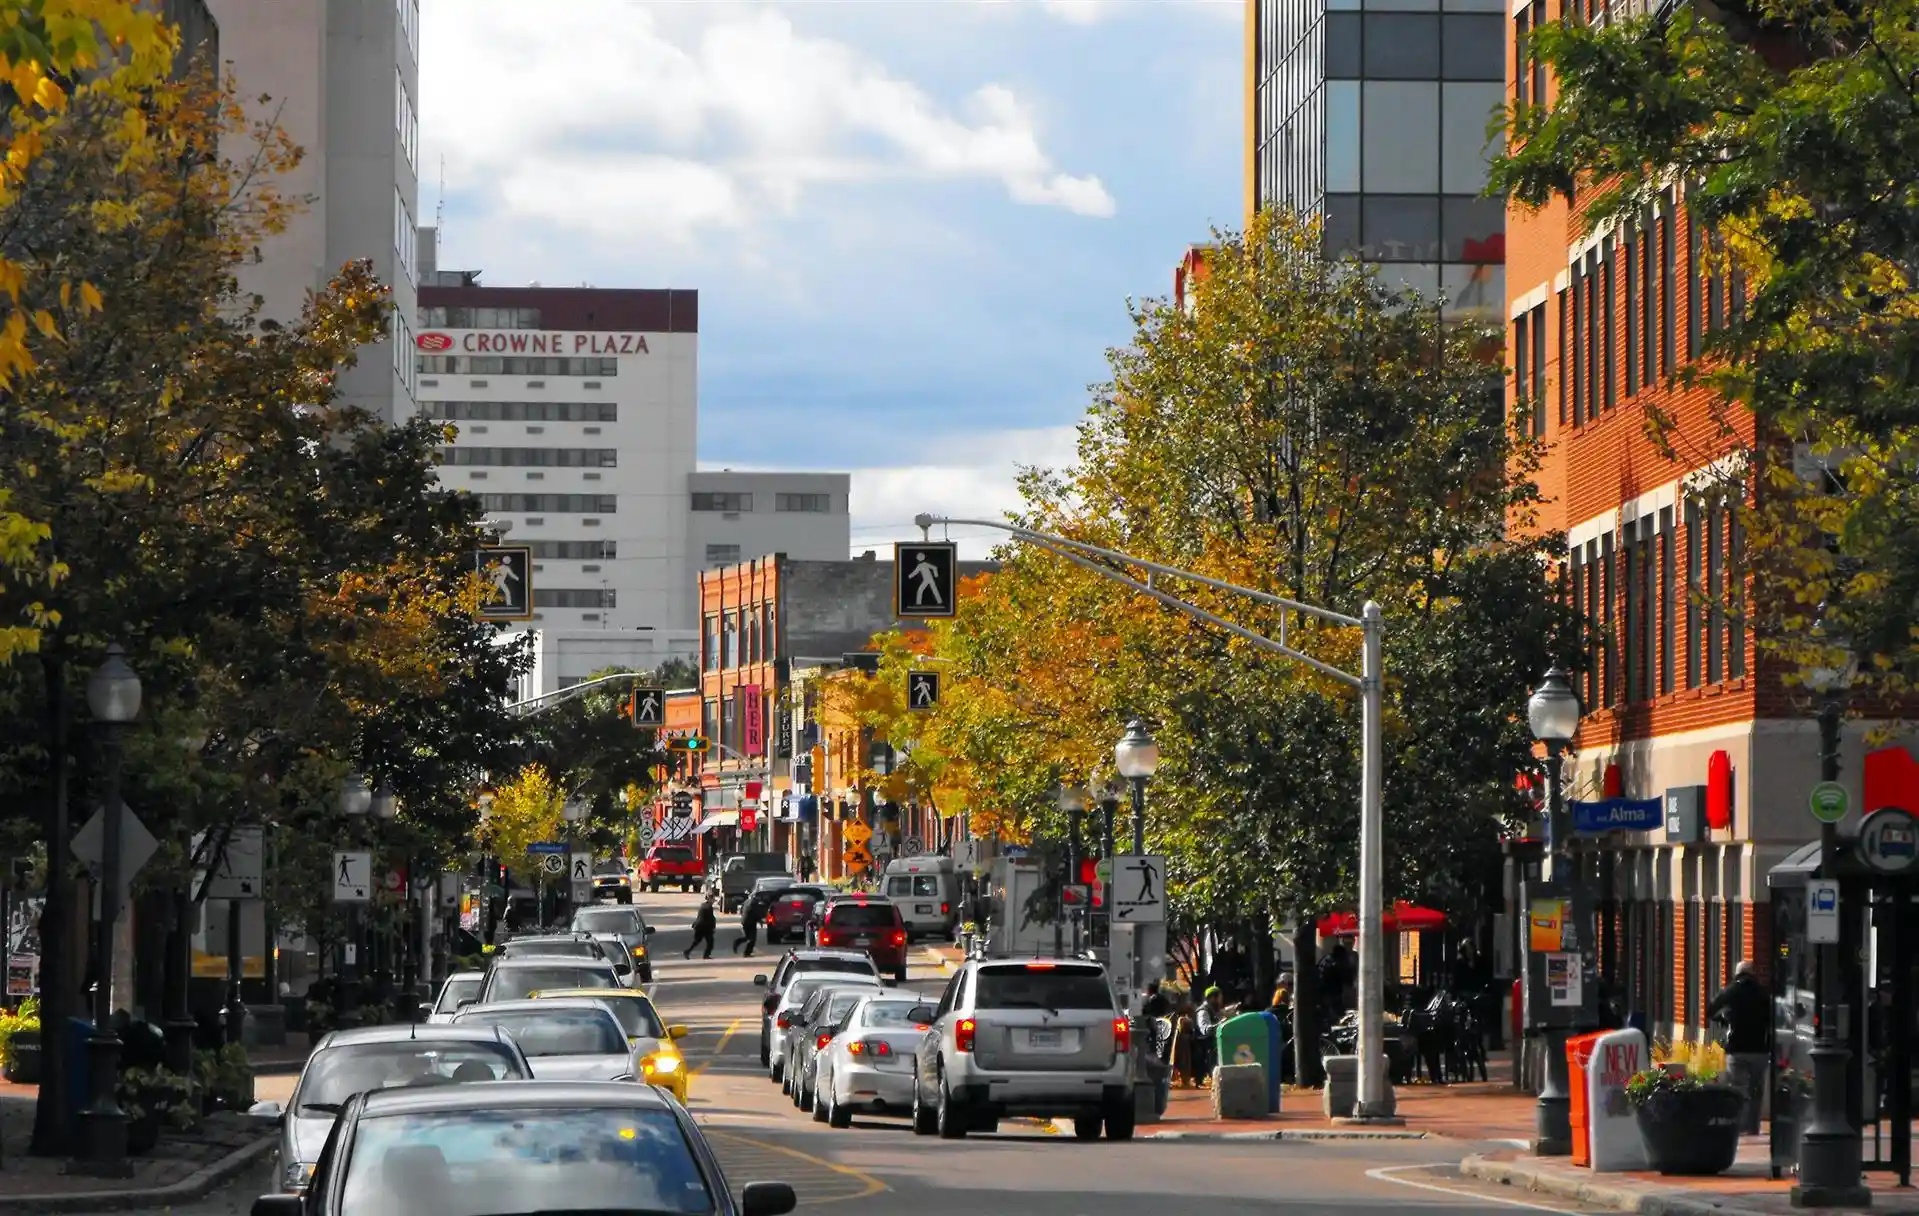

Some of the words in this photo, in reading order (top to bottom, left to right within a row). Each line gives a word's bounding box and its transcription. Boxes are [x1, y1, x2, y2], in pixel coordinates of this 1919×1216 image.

[463, 333, 563, 353] CROWNE
[575, 334, 649, 354] PLAZA
[1609, 806, 1645, 822] Alma
[1605, 1043, 1639, 1072] NEW
